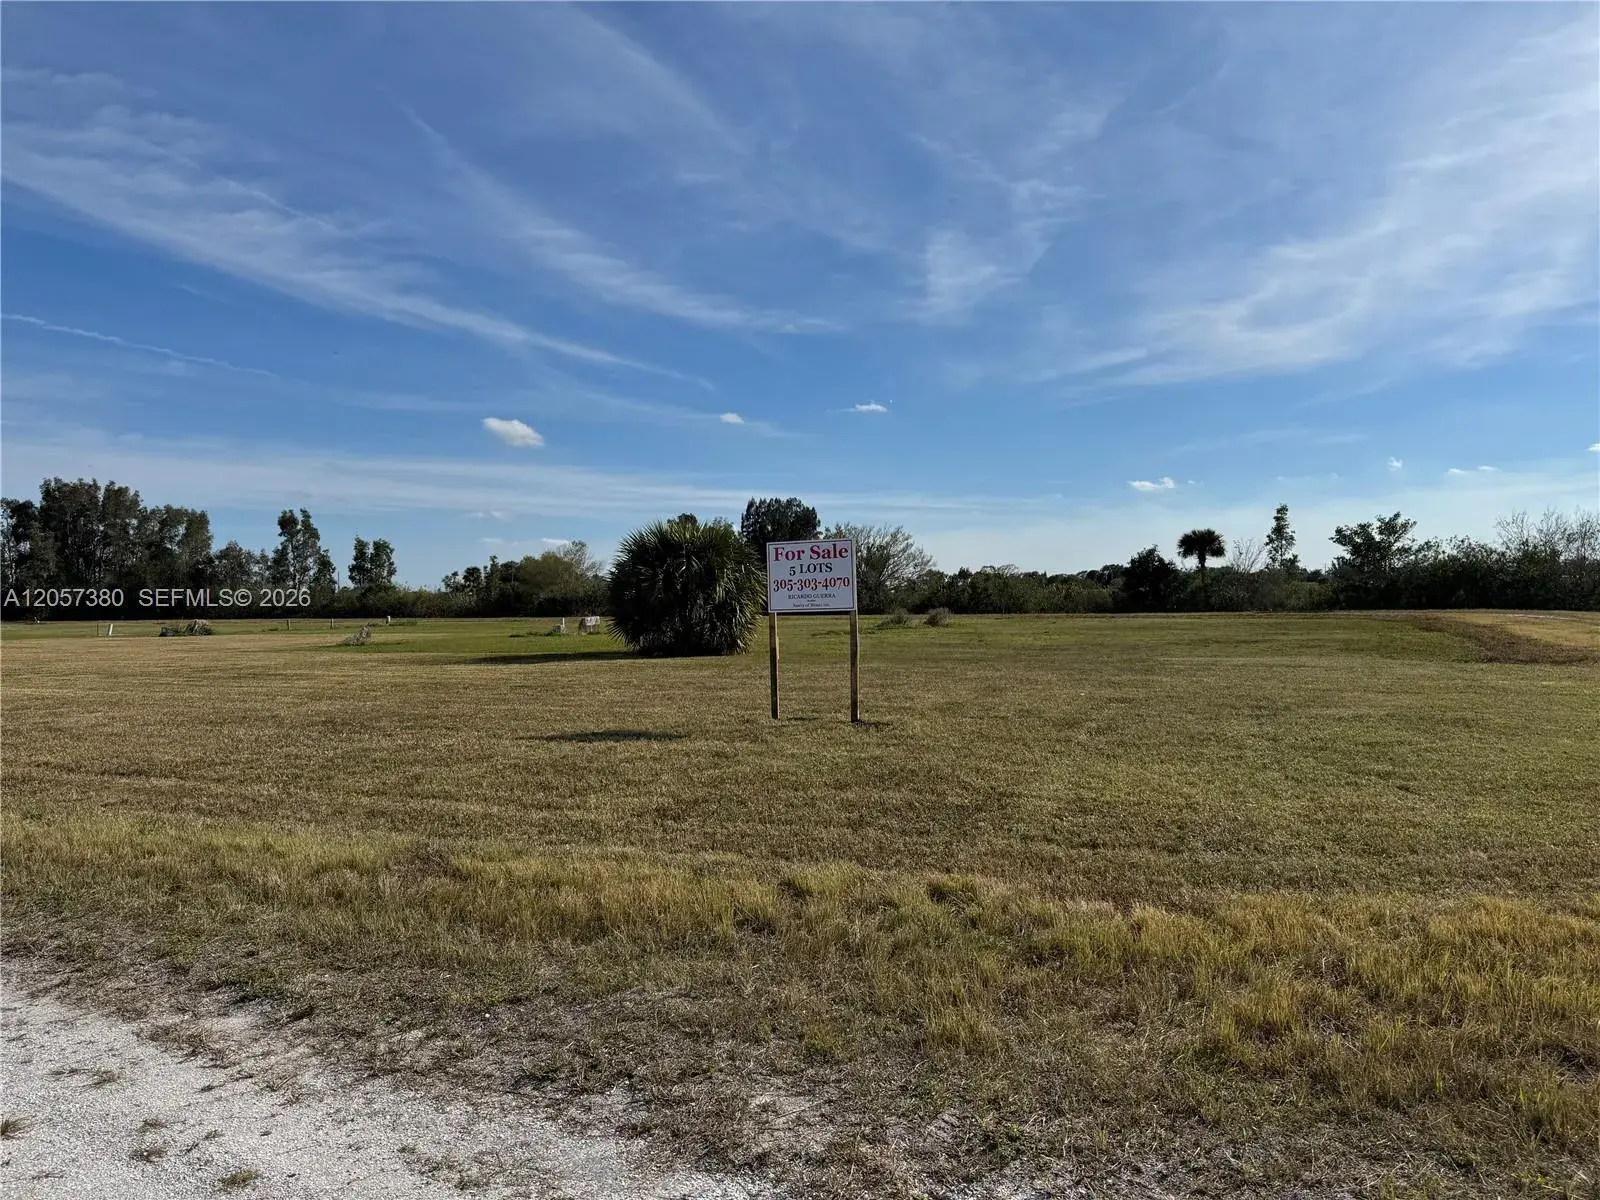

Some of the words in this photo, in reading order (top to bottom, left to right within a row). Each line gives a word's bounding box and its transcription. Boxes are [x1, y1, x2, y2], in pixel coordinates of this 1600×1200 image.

[773, 547, 805, 562] For
[809, 543, 849, 560] Sale
[789, 566, 796, 576] 5
[799, 562, 833, 574] LOTS
[773, 576, 850, 593] 305-303-4070
